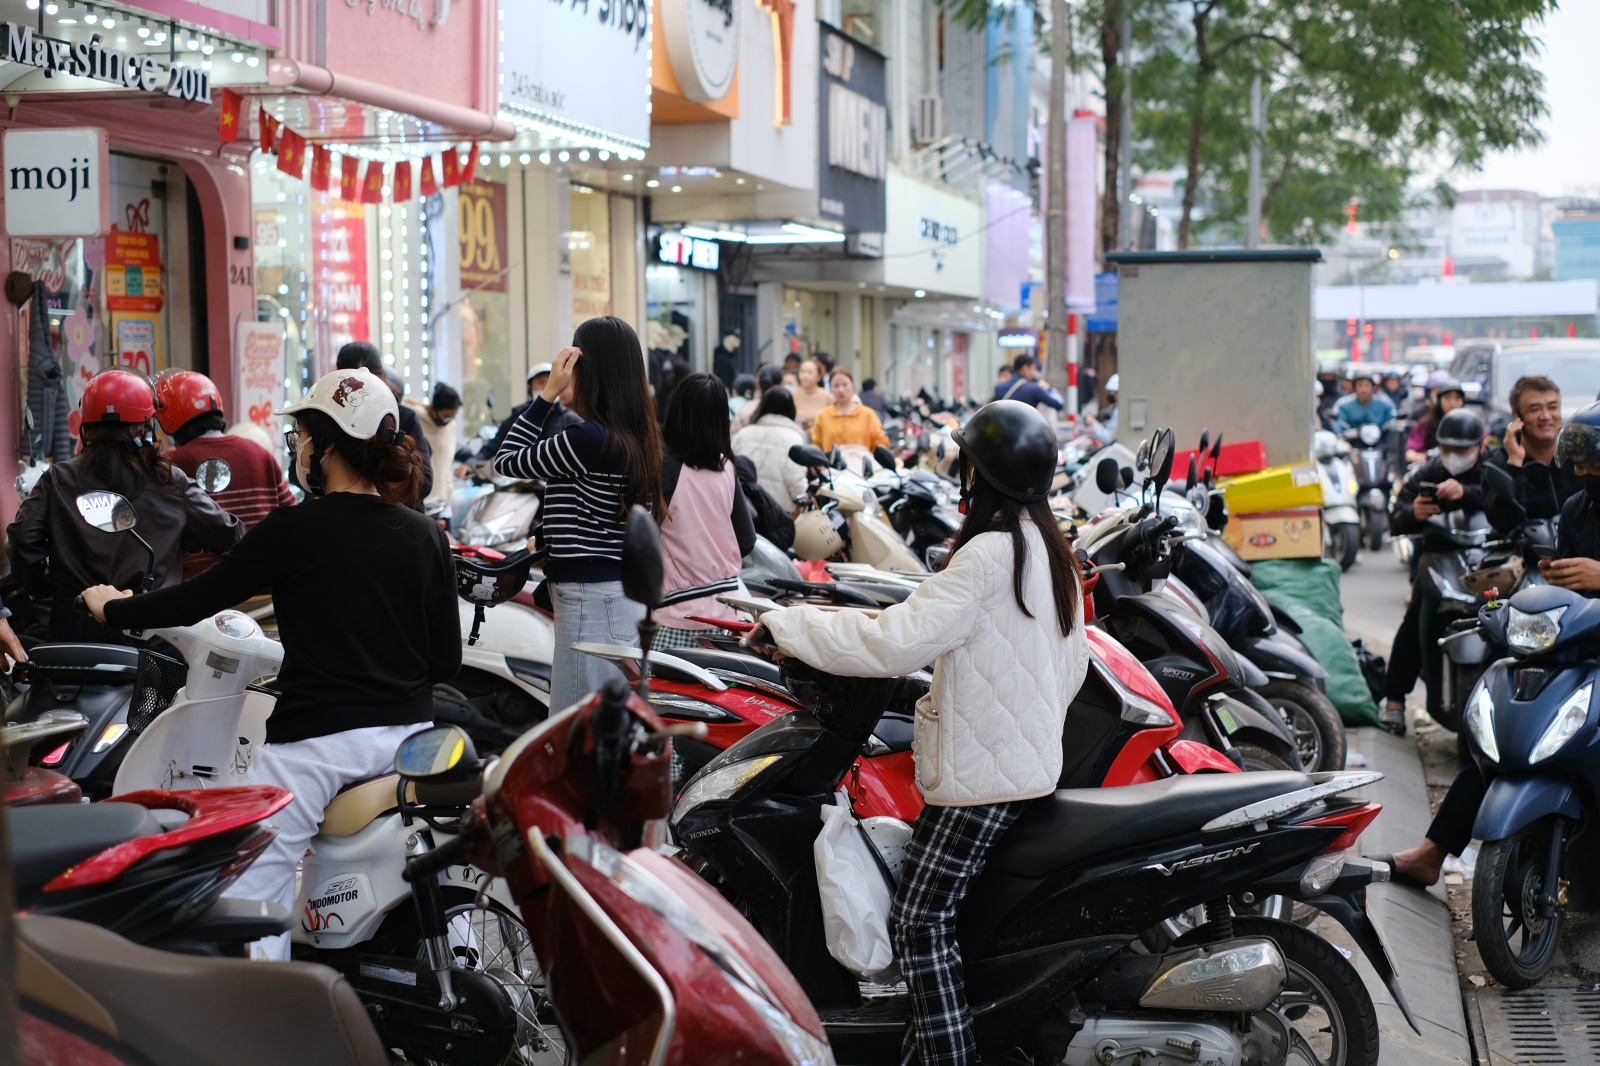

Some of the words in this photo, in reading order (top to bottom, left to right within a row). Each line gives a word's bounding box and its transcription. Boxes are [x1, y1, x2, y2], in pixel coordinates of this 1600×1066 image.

[167, 62, 213, 105] 2011
[10, 157, 92, 202] moji
[230, 264, 253, 286] 241
[1162, 666, 1196, 679] SPORTY
[690, 826, 721, 840] HONDA
[1142, 842, 1260, 877] VISION
[310, 889, 358, 910] INDOMOTOR
[1194, 995, 1245, 1005] HONDA
